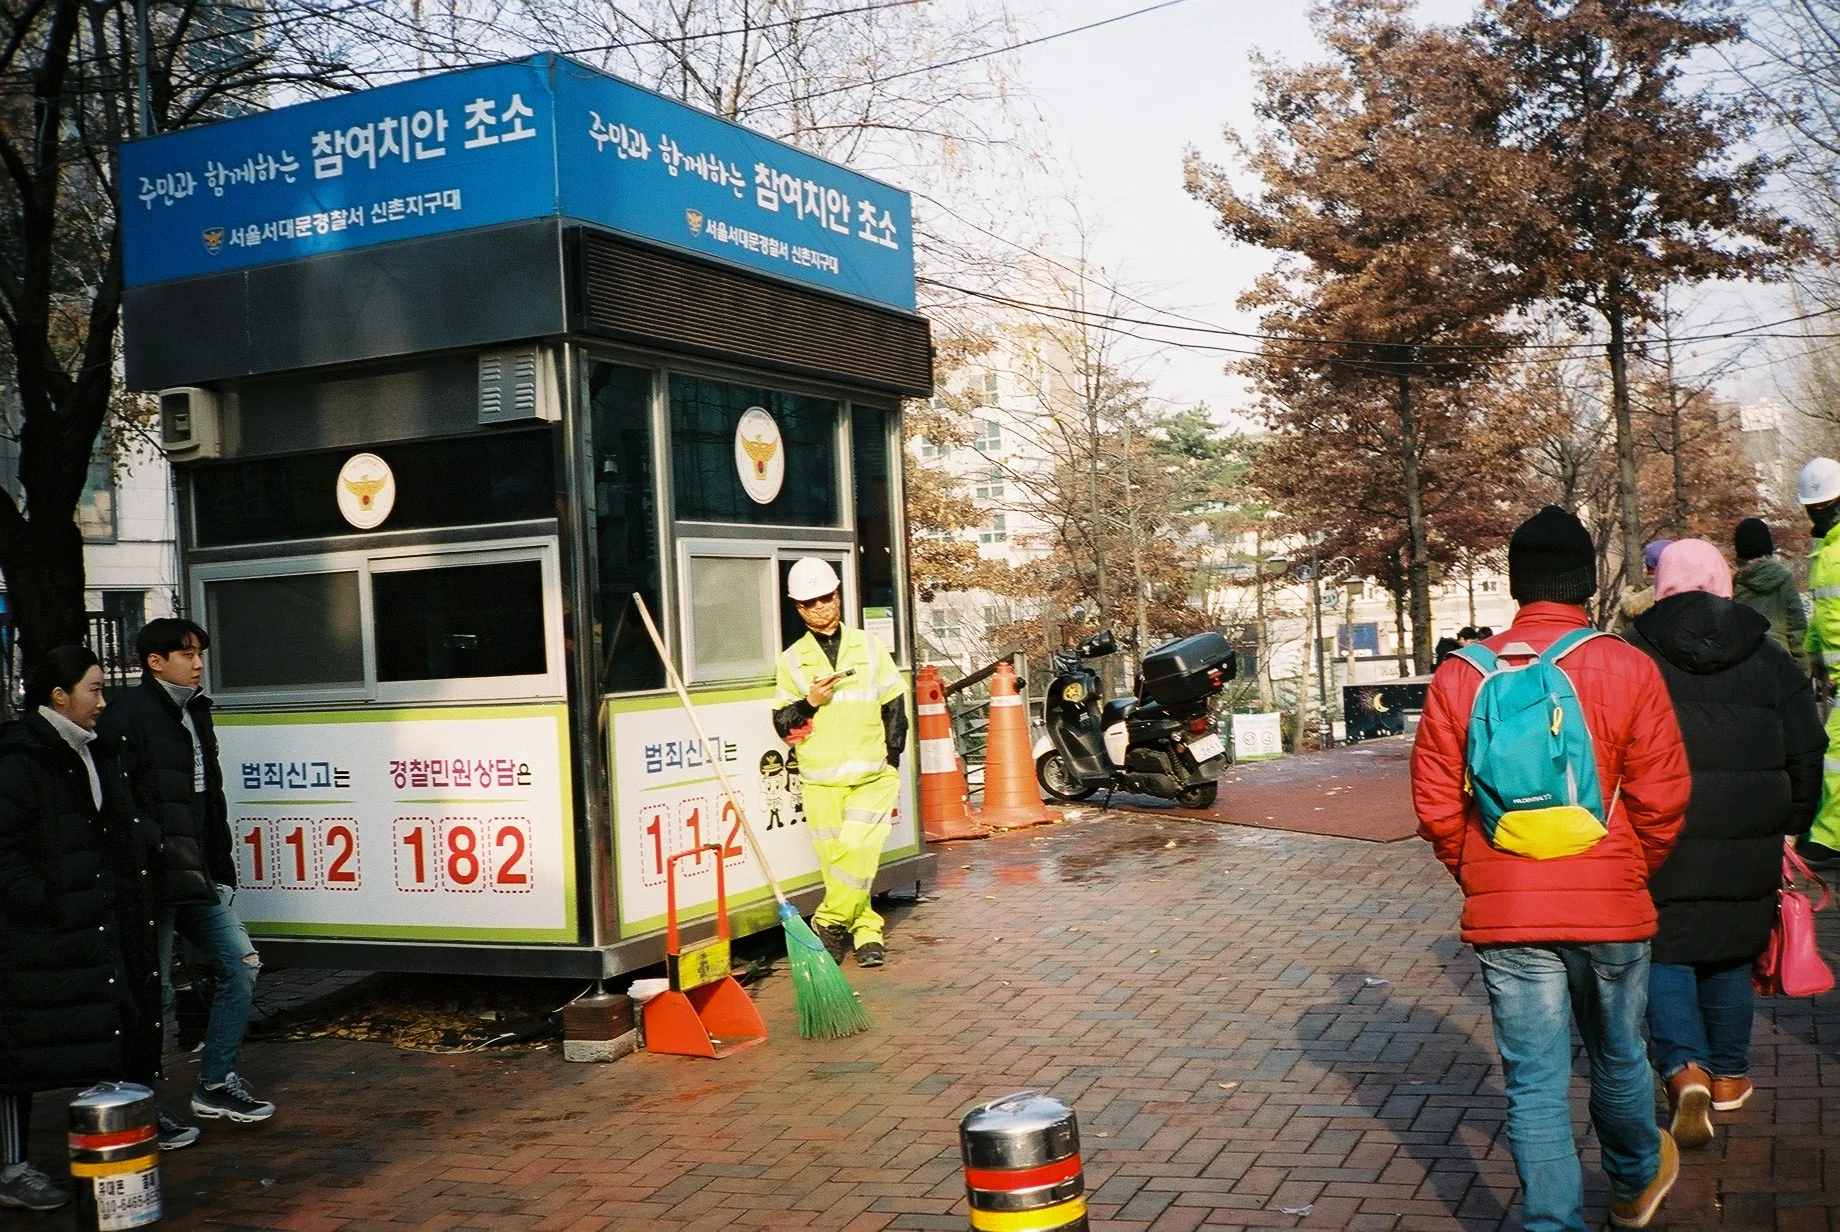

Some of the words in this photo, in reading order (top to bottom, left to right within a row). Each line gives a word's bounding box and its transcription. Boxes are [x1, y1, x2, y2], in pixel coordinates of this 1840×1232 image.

[138, 171, 198, 210] 주민과
[204, 149, 300, 197] 함께하는
[311, 108, 449, 180] 참여치안
[463, 93, 537, 150] 초소
[588, 110, 652, 162] 주민과
[658, 134, 746, 199] 함께하는
[754, 161, 851, 236] 참여치안
[857, 199, 899, 251] 초소
[229, 204, 365, 248] 서울서대문경찰서
[371, 187, 462, 222] 신촌지구대
[705, 218, 789, 262] 서울서대문경찰서
[791, 245, 839, 275] 신촌지구대
[241, 761, 350, 791] 범죄신고는
[389, 758, 532, 789] 경찰민원상담은
[243, 825, 356, 883] 112
[403, 825, 528, 885] 182
[646, 800, 743, 875] 112
